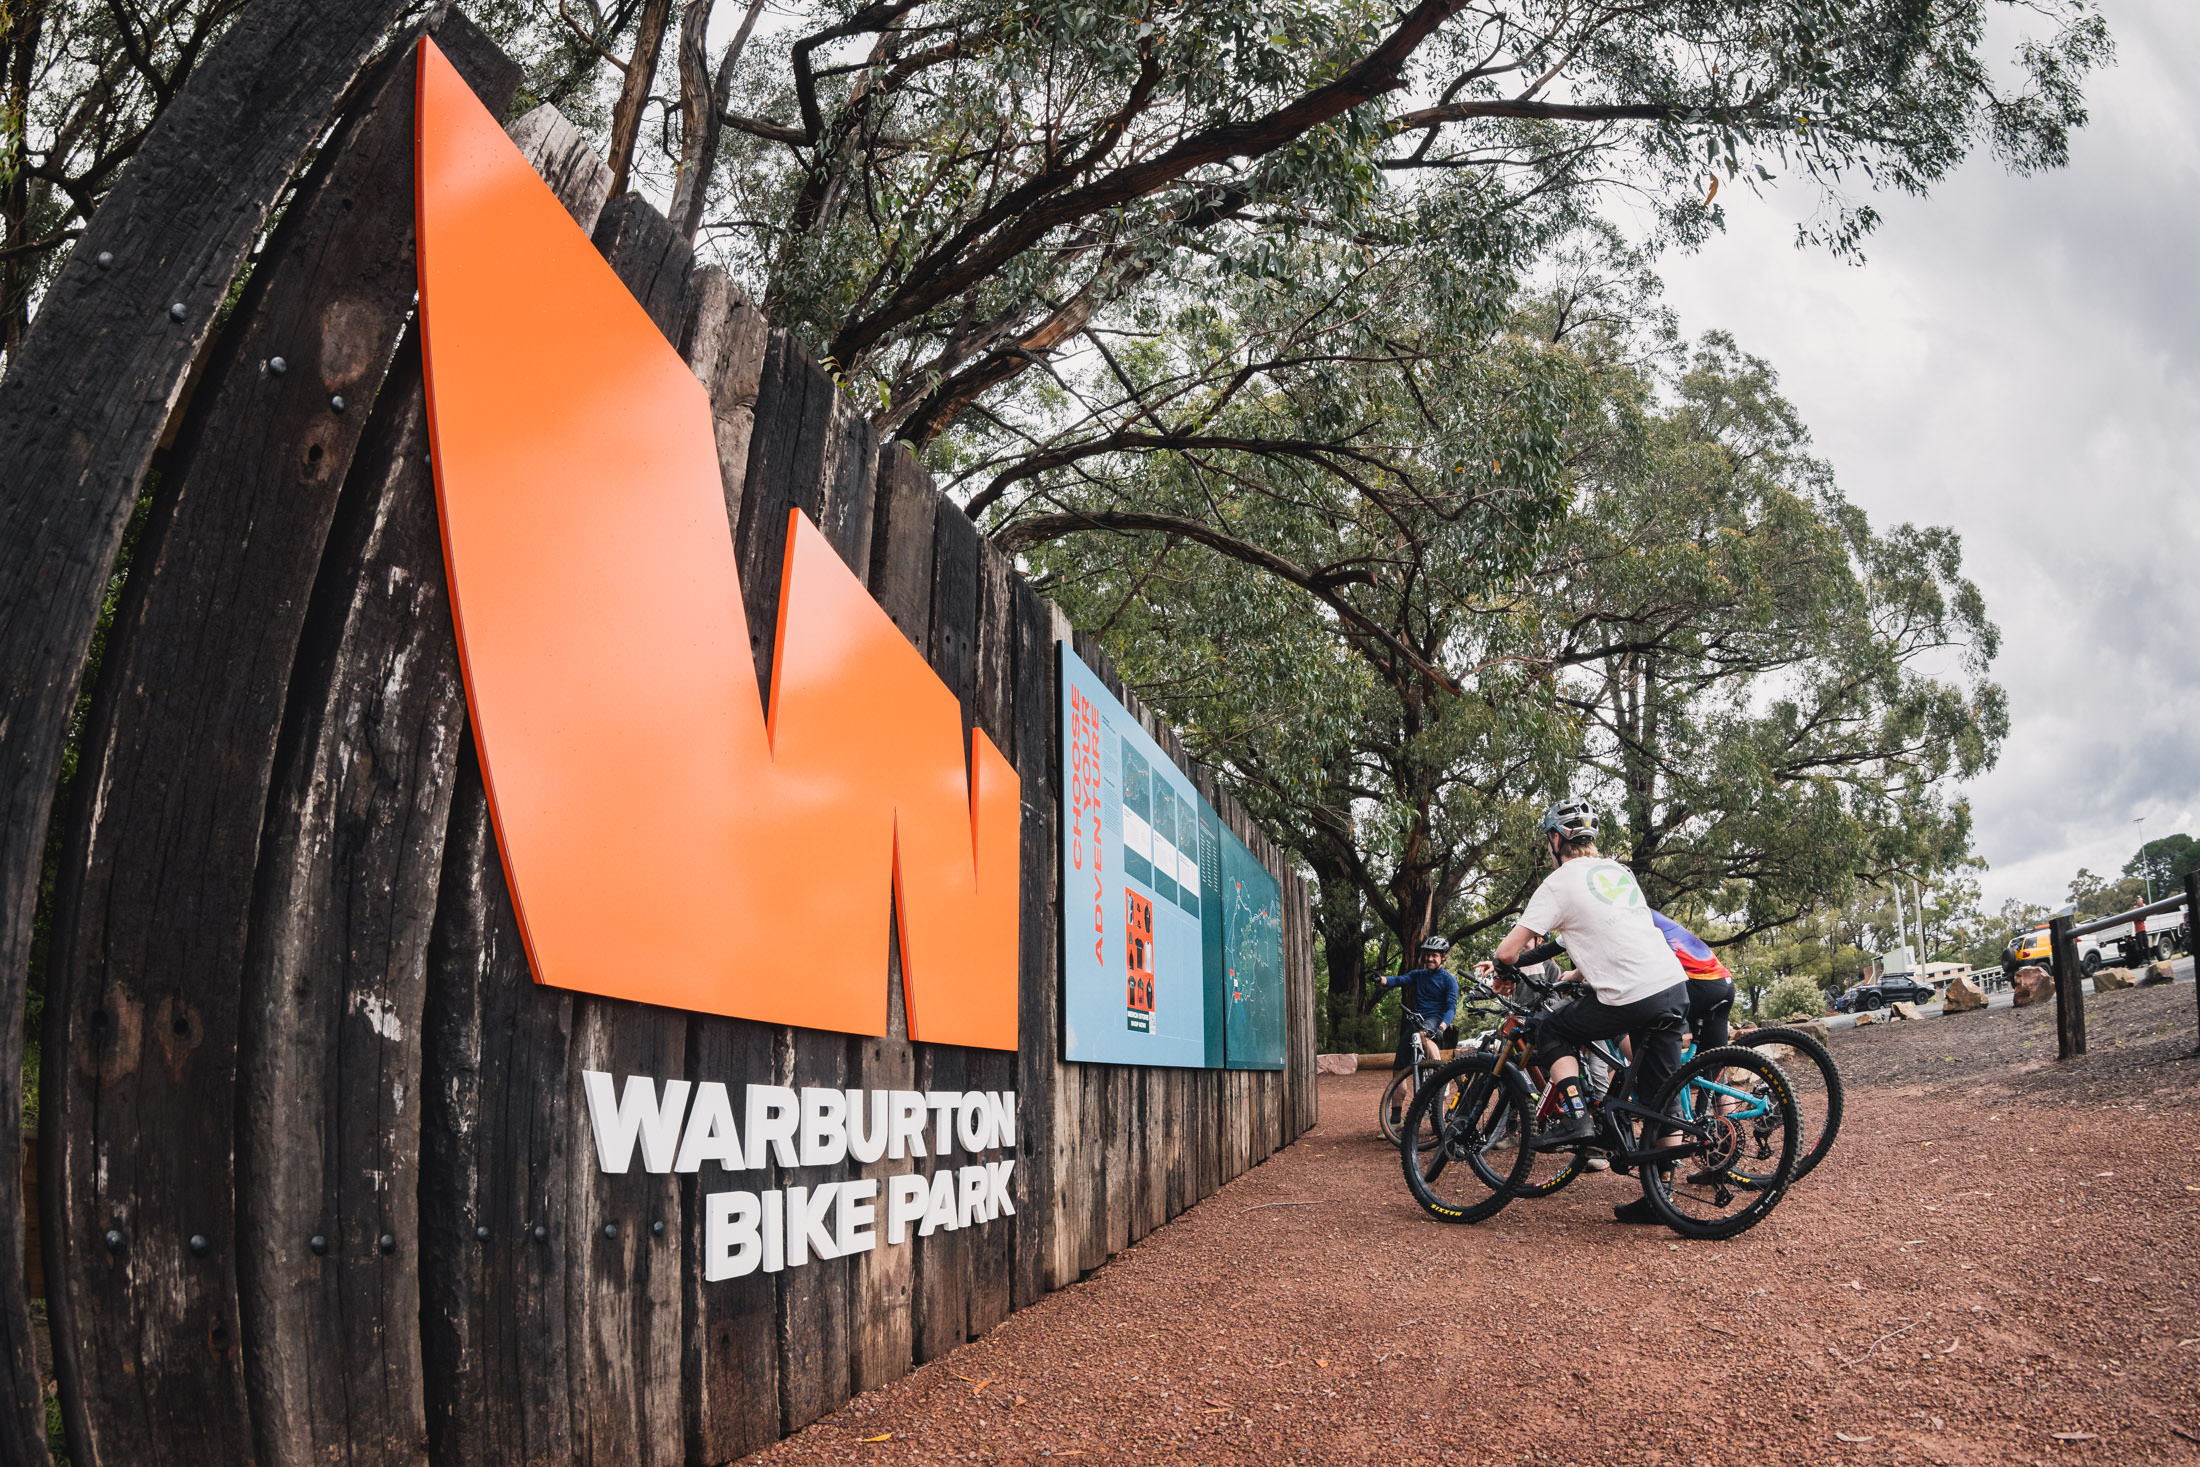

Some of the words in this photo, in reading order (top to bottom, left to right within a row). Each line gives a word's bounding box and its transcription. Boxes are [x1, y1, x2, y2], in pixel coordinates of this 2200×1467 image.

[1071, 683, 1082, 871] CHOOSE
[1081, 695, 1091, 813] YOUR
[1091, 703, 1104, 967] ADVENTURE
[582, 1070, 1016, 1174] WARBURTON
[1760, 1066, 1788, 1104] MAXXIS
[705, 1178, 876, 1282] BIKE
[888, 1159, 1016, 1245] PARK
[1431, 1204, 1462, 1216] MAXXIS
